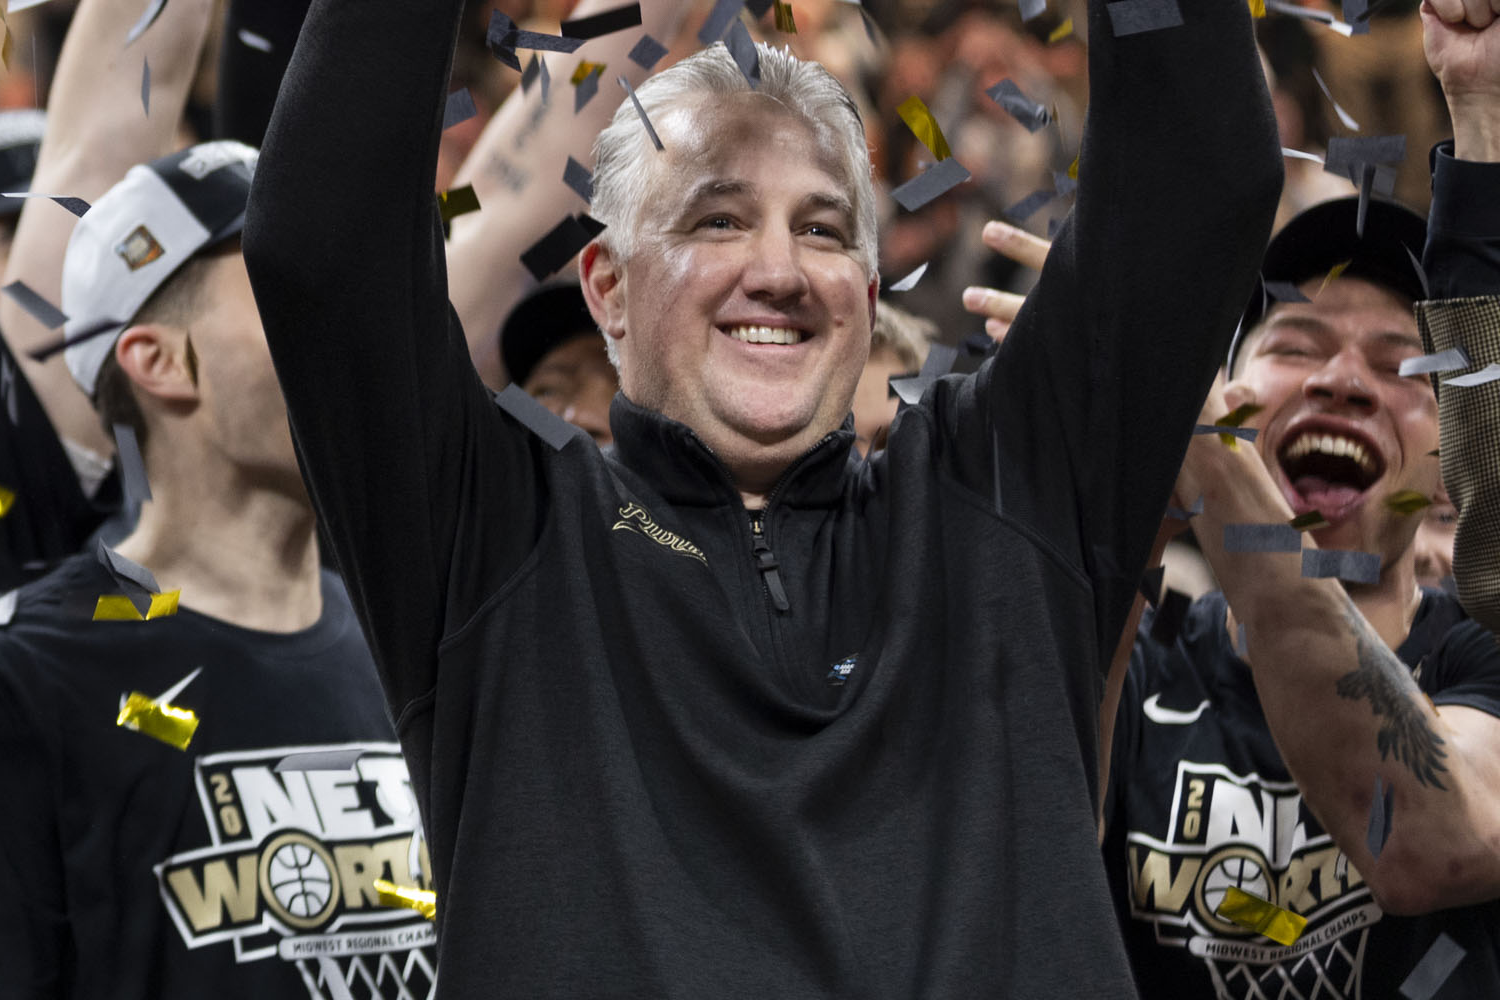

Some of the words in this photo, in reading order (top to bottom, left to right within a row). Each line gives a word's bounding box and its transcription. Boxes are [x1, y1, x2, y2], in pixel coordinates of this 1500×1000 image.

[209, 772, 243, 837] 20
[1182, 778, 1206, 840] 20
[293, 939, 342, 953] MIDWEST
[346, 934, 395, 949] REGIONAL
[1205, 942, 1265, 963] MIDWEST
[1269, 931, 1323, 962] REGIONAL
[1323, 909, 1368, 940] CHAMPS
